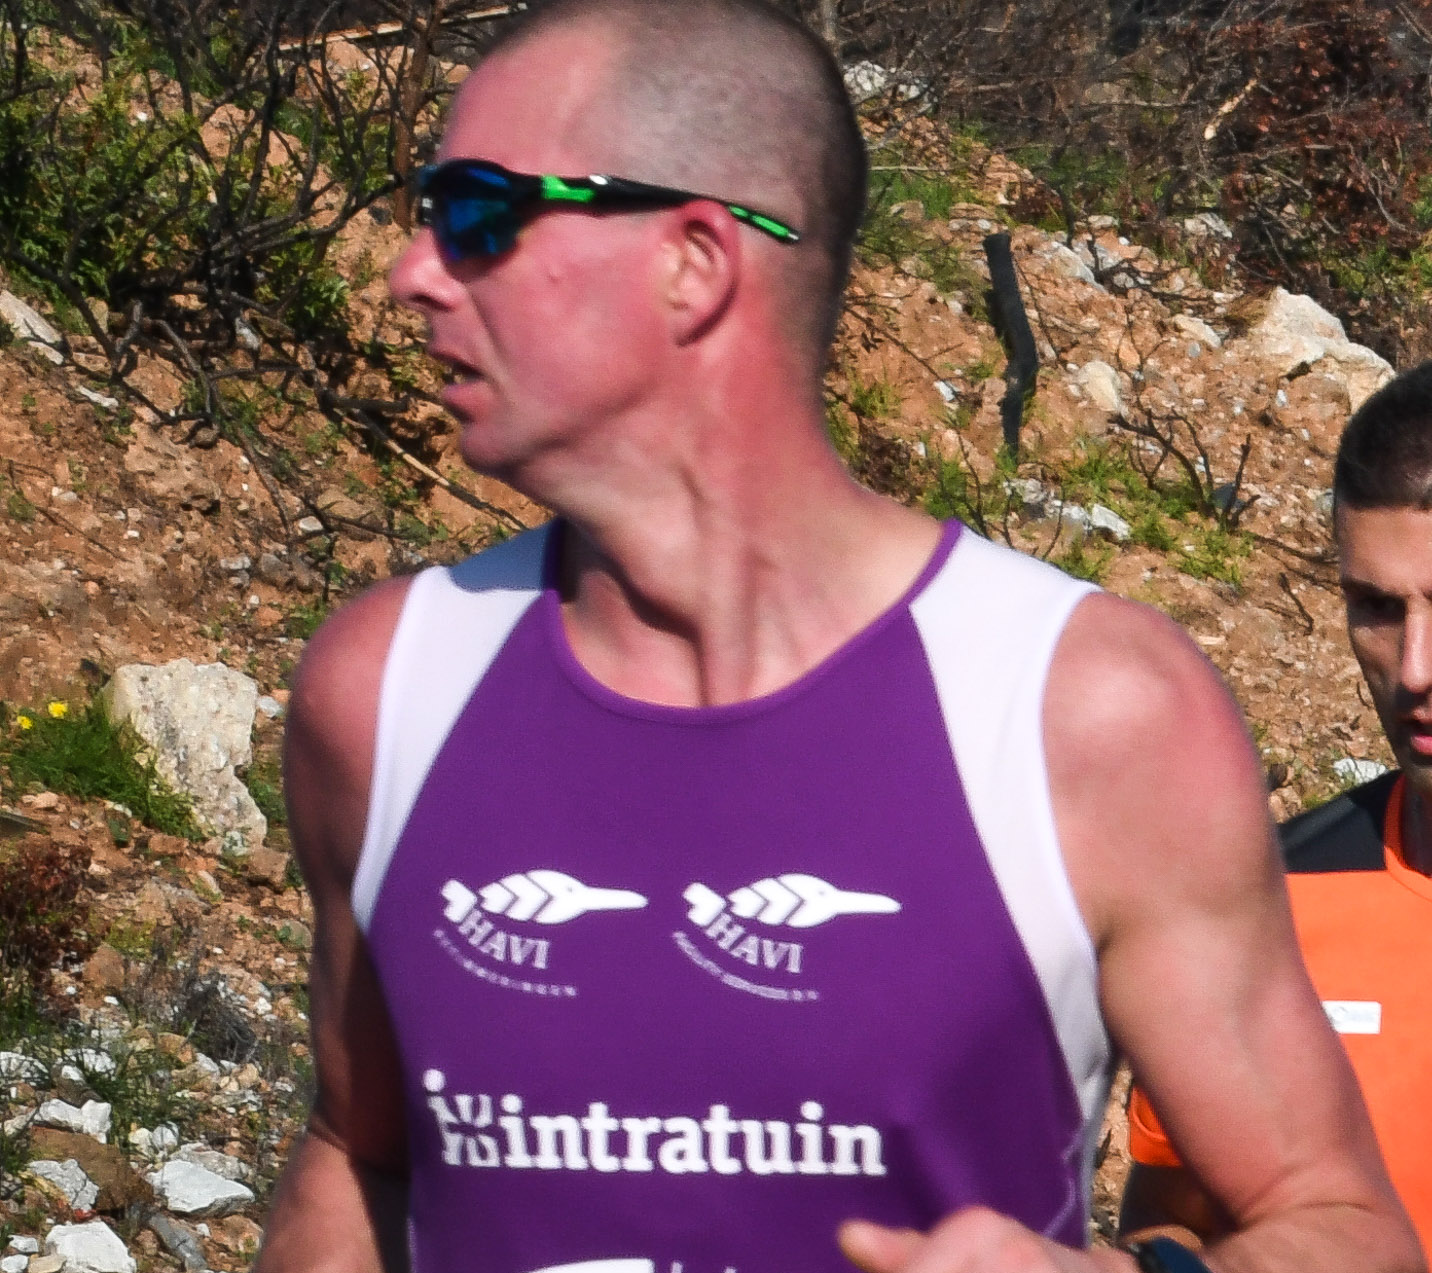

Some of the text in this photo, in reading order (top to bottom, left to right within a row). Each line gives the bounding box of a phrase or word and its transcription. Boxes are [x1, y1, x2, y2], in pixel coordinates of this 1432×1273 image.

[457, 909, 551, 970] HAVI
[704, 912, 805, 974] HAVI
[498, 1093, 888, 1177] intratuin
